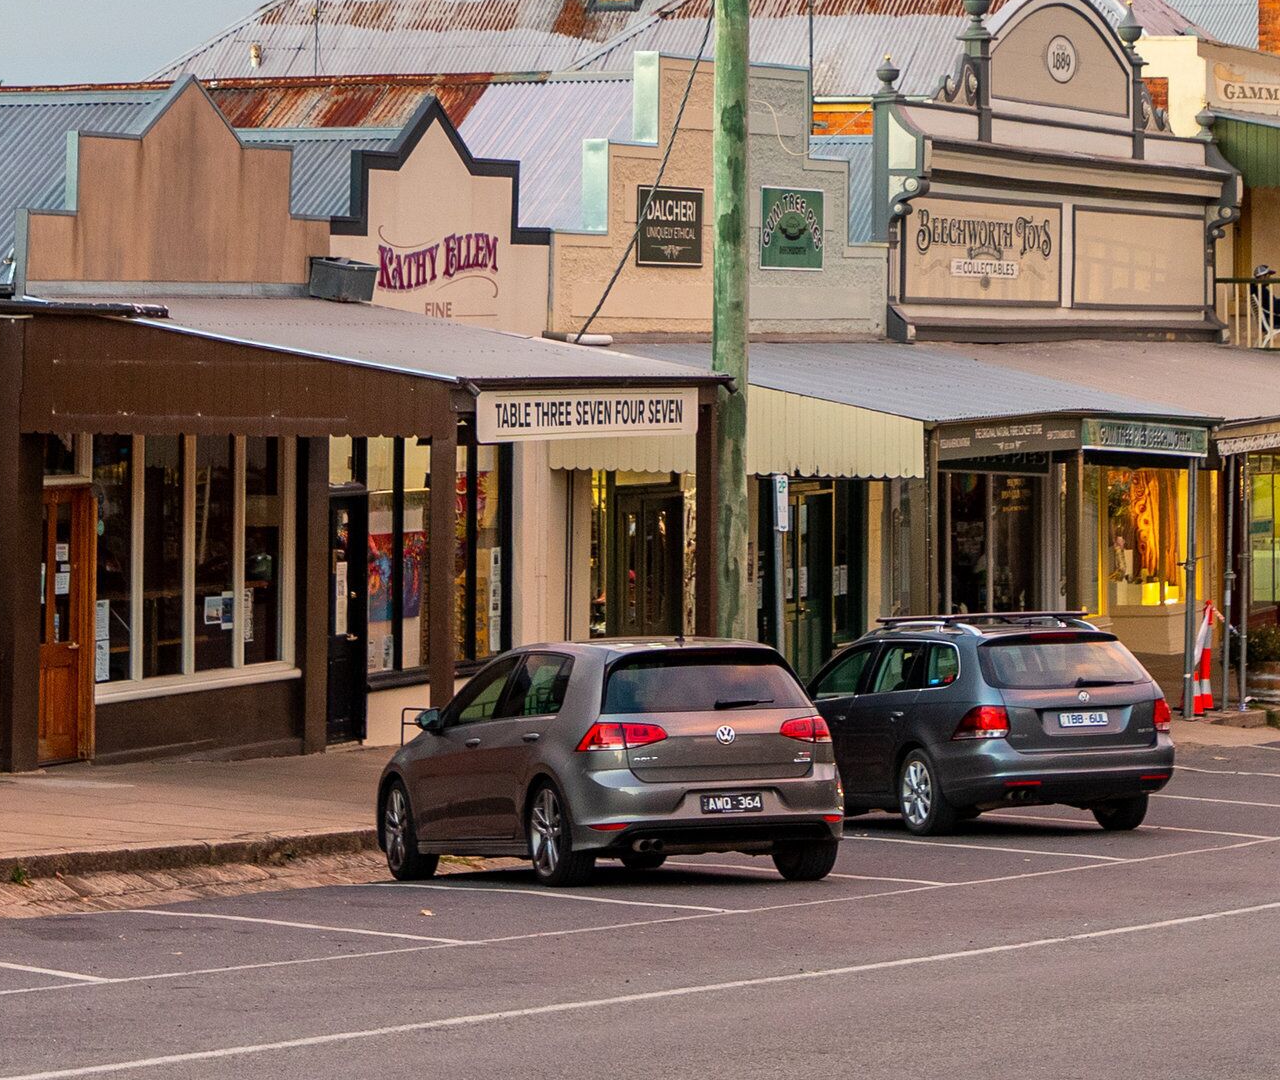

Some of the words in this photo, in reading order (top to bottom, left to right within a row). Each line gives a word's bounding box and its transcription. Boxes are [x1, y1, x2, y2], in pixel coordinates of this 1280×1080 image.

[1052, 51, 1071, 73] 1889
[763, 201, 783, 248] GUM
[782, 193, 807, 217] TREE
[806, 208, 823, 252] PIES
[916, 208, 1014, 253] BEECHWORTH
[1015, 215, 1053, 259] TOYS
[378, 243, 440, 291] KATHY
[443, 232, 499, 278] ELLEM
[963, 261, 1015, 276] COLLECTABLES
[424, 301, 453, 318] FINE
[495, 402, 532, 428] TABLE
[534, 401, 572, 427] THREE
[575, 400, 612, 426] SEVEN
[615, 399, 645, 425] FOUR
[648, 399, 683, 424] SEVEN
